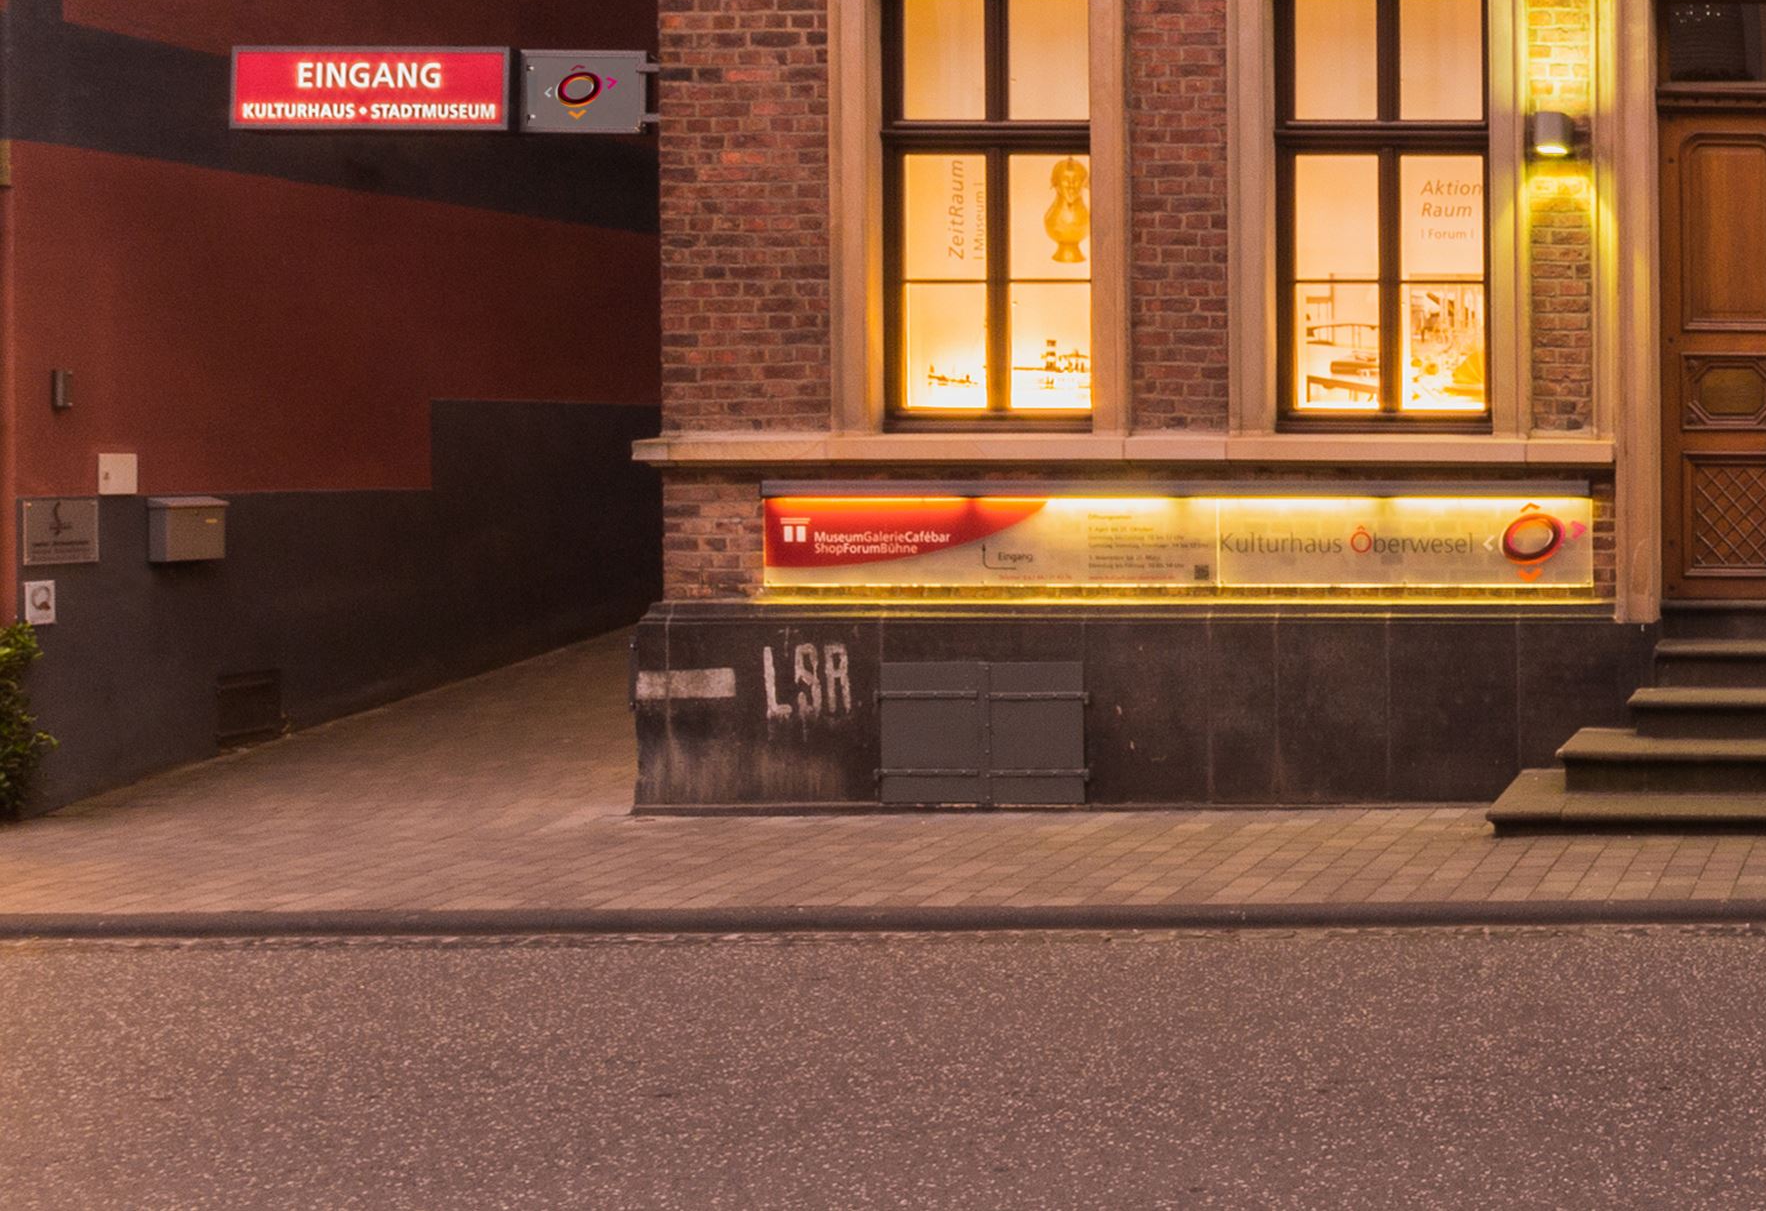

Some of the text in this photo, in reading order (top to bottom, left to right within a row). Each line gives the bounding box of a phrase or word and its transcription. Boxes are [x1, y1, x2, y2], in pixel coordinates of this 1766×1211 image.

[296, 62, 442, 88] EINGANG
[242, 103, 496, 119] KULTURHAUS STADTMUSEUM
[1420, 179, 1484, 196] Aktion
[948, 159, 965, 260] ZeitRaum
[1421, 202, 1473, 217] Raum
[974, 191, 985, 252] Museum
[1428, 228, 1467, 239] Forum
[813, 530, 951, 543] MuseumGalerieCafébar
[1220, 531, 1342, 554] Kulturhaus
[997, 551, 1034, 563] Eingang
